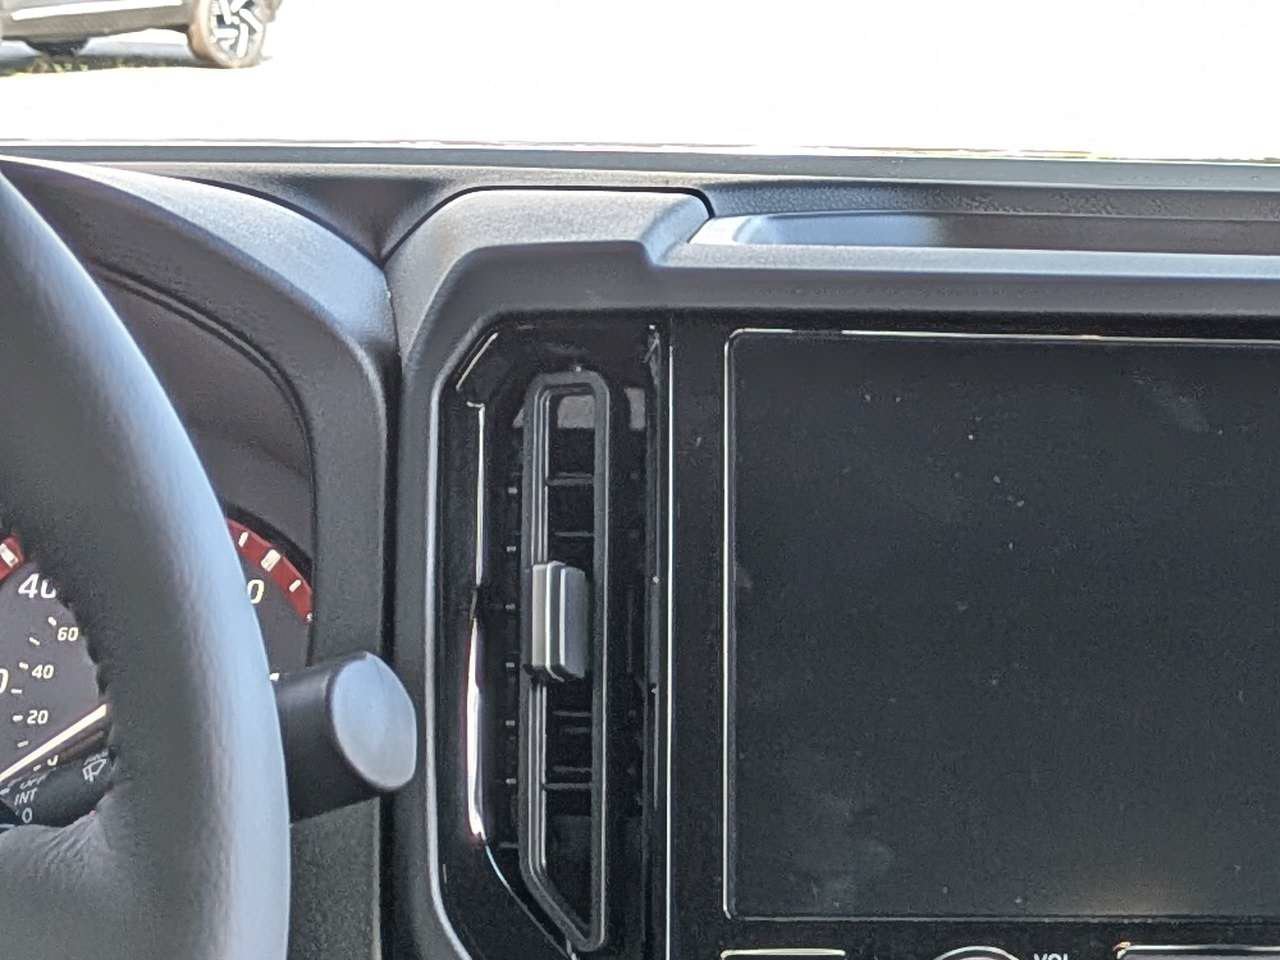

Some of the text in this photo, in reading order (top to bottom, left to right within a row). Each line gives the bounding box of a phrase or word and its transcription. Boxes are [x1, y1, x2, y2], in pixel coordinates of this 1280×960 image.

[57, 627, 79, 641] 60
[31, 664, 54, 679] 40
[27, 710, 48, 725] 20
